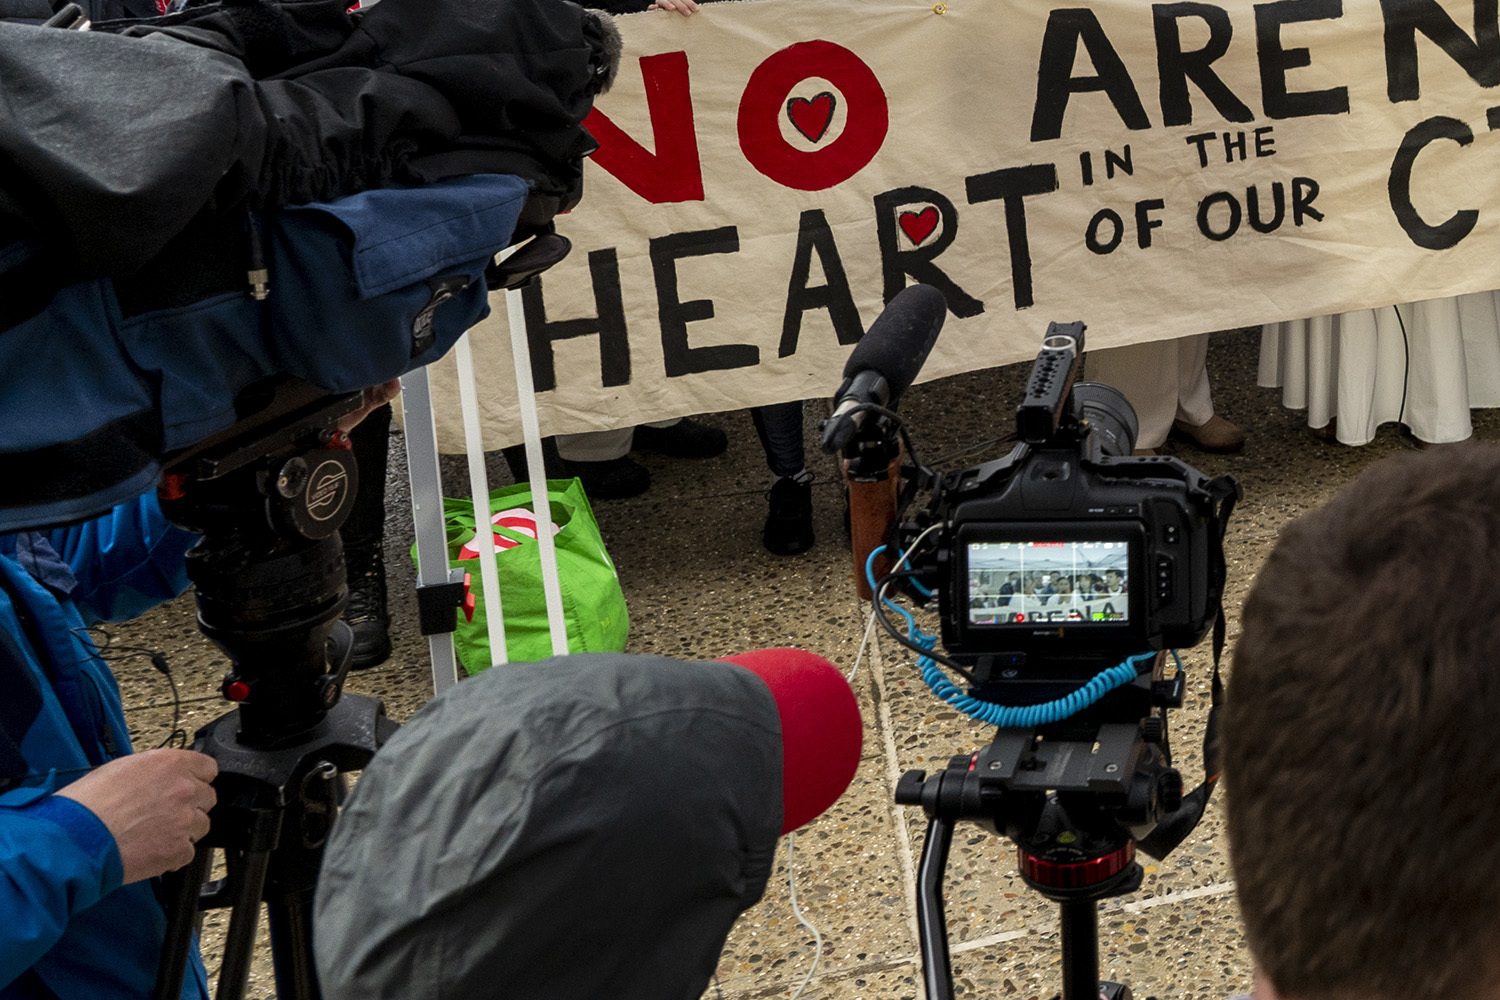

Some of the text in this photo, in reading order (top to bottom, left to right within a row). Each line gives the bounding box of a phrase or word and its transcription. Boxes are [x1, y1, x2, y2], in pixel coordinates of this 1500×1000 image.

[581, 39, 889, 204] NO
[1079, 125, 1277, 187] IN THE
[521, 163, 1060, 393] HEART
[1085, 198, 1165, 255] OF
[1196, 177, 1325, 243] OUR
